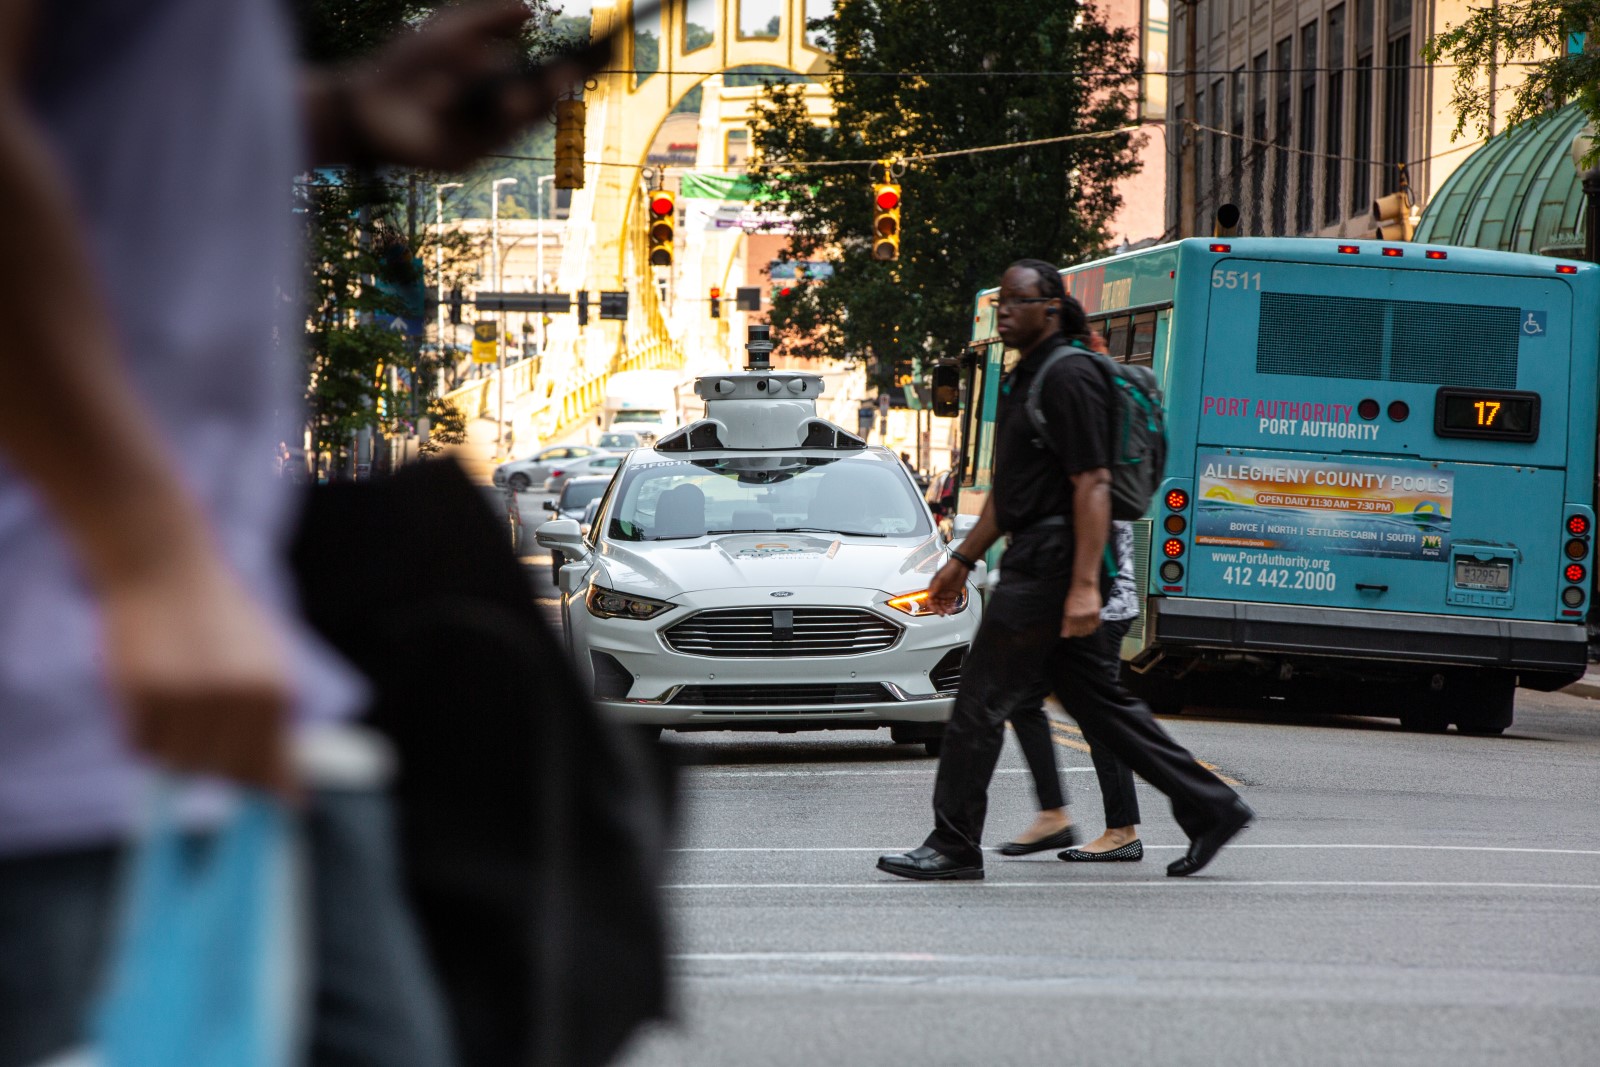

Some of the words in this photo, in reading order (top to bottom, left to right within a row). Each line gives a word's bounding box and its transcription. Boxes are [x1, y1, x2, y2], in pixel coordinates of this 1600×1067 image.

[1212, 269, 1261, 291] 5511
[1203, 396, 1250, 417] PORT
[1255, 399, 1353, 424] AUTHORITY
[1474, 401, 1501, 426] 17
[1259, 418, 1298, 436] PORT
[1301, 420, 1380, 441] AUTHORITY
[1204, 463, 1310, 484] ALLEGHENY
[1314, 470, 1387, 489] COUNTY
[1391, 475, 1449, 493] POOLS
[1258, 494, 1283, 505] OPEN
[1285, 496, 1309, 506] DAILY
[1310, 498, 1333, 508] 11:30
[1333, 499, 1349, 509] AM
[1357, 501, 1374, 511] 7:30
[1375, 502, 1391, 512] PM
[1230, 522, 1258, 532] BOYCE
[1267, 525, 1297, 535] NORTH
[1306, 527, 1350, 538] SETTLERS
[1350, 530, 1377, 540] CABIN
[1386, 532, 1416, 543] SOUTH
[1211, 552, 1330, 572] www.PortAuthority.org
[1222, 566, 1252, 586] 412
[1257, 568, 1336, 592] 442.2000
[1455, 593, 1507, 606] GILLIG
